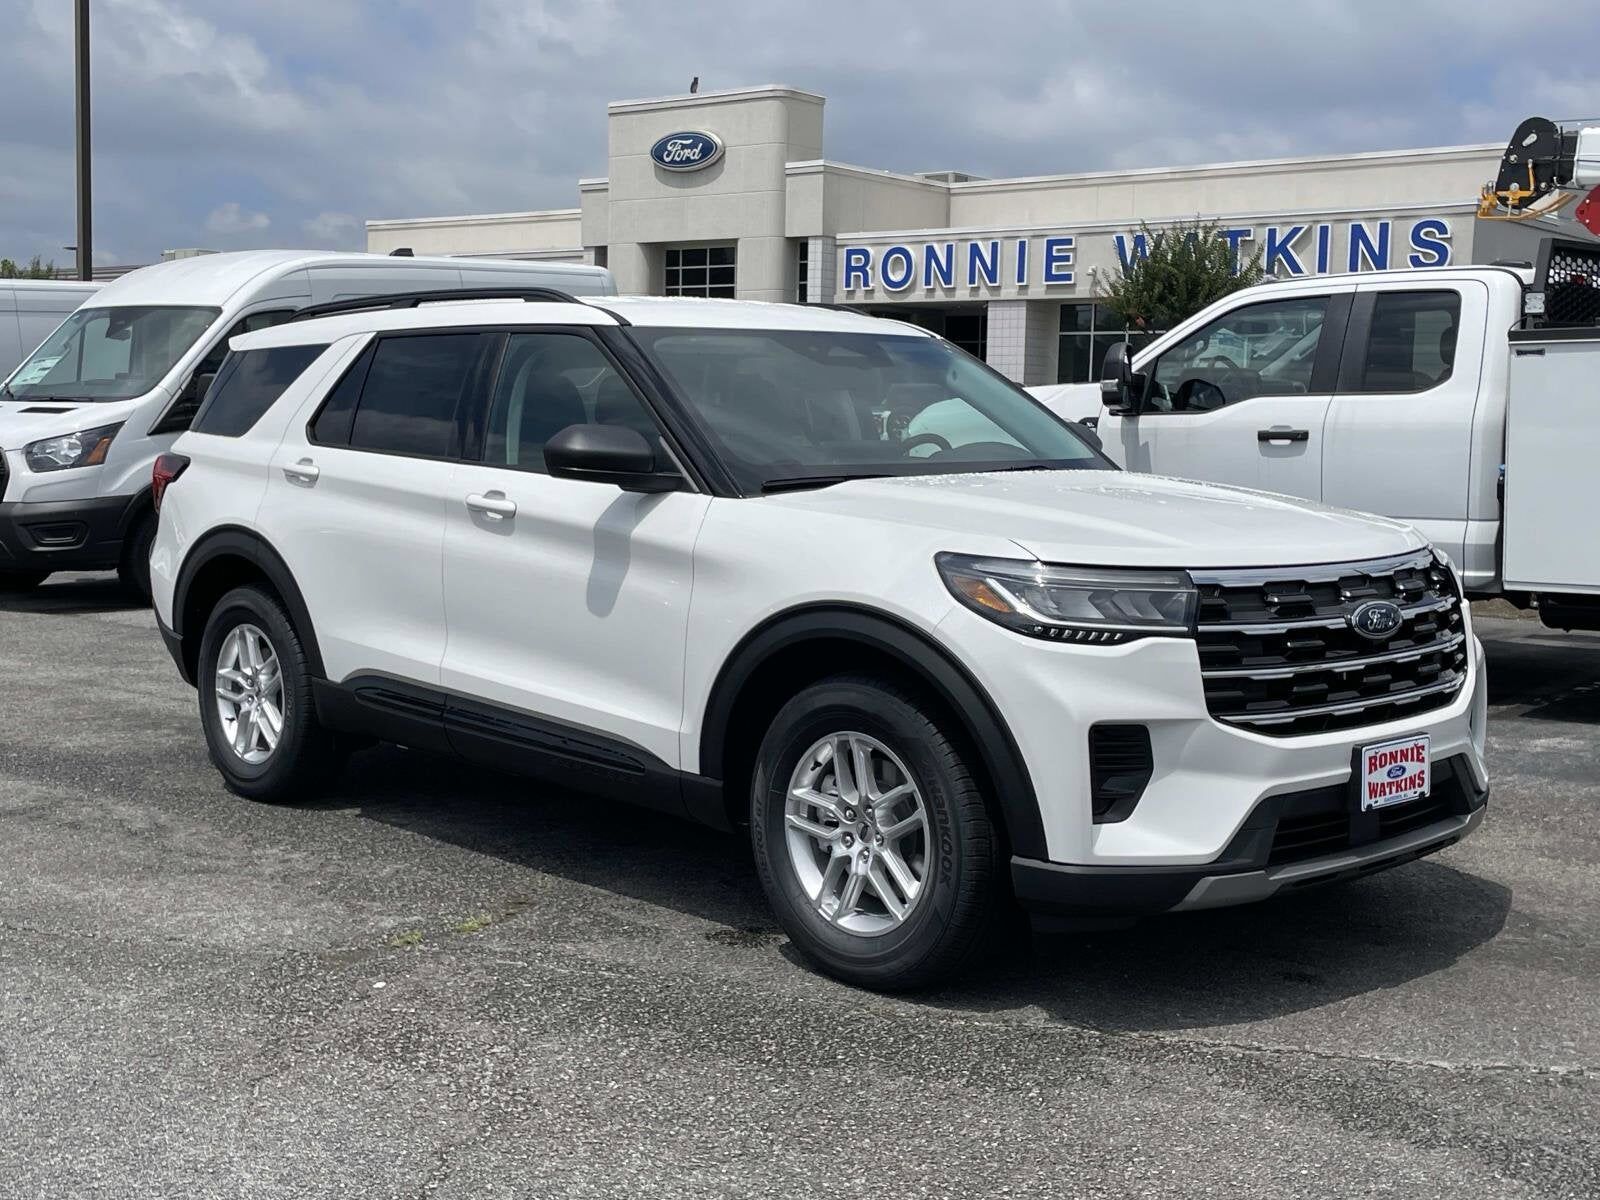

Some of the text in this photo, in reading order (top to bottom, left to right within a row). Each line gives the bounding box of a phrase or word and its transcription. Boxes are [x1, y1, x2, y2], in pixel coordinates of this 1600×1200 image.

[663, 139, 703, 162] Ford
[843, 236, 1076, 292] RONNIE
[1367, 608, 1395, 630] Ford
[1368, 745, 1425, 775] RONNIE
[1368, 770, 1425, 800] WATKINS
